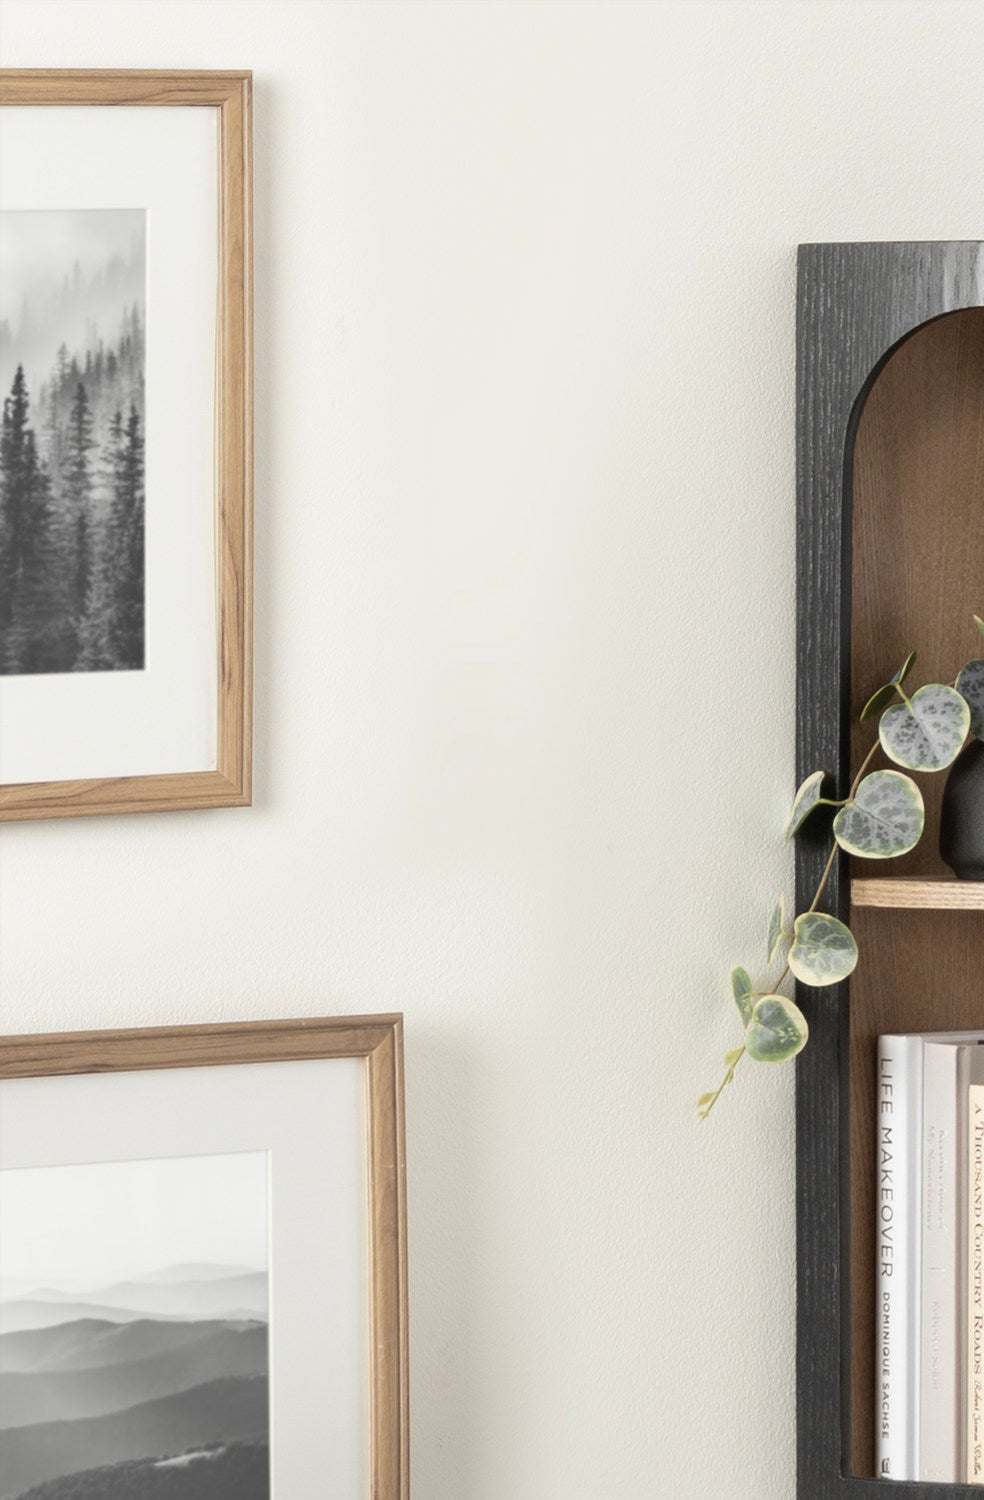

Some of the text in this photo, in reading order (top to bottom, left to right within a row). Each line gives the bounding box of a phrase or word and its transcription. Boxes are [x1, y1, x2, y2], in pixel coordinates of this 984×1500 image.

[974, 1104, 982, 1114] A
[881, 1058, 893, 1277] LIFE MAKEOVER
[882, 1292, 890, 1376] DOMINIQUE
